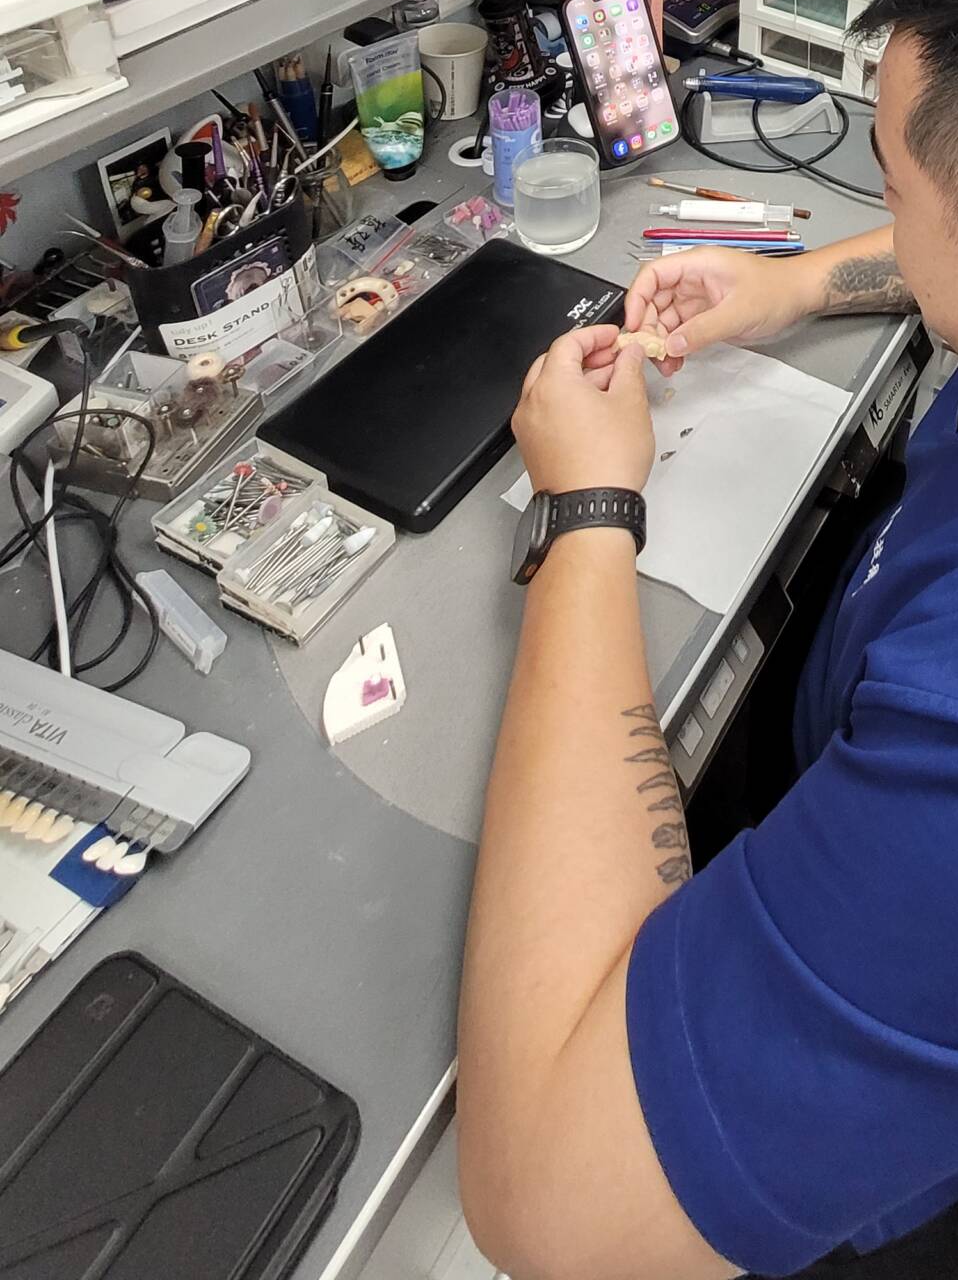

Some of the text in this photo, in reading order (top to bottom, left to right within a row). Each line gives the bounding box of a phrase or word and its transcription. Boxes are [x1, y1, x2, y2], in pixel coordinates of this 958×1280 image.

[174, 302, 270, 346] DESK STAND
[29, 719, 68, 744] VITA
